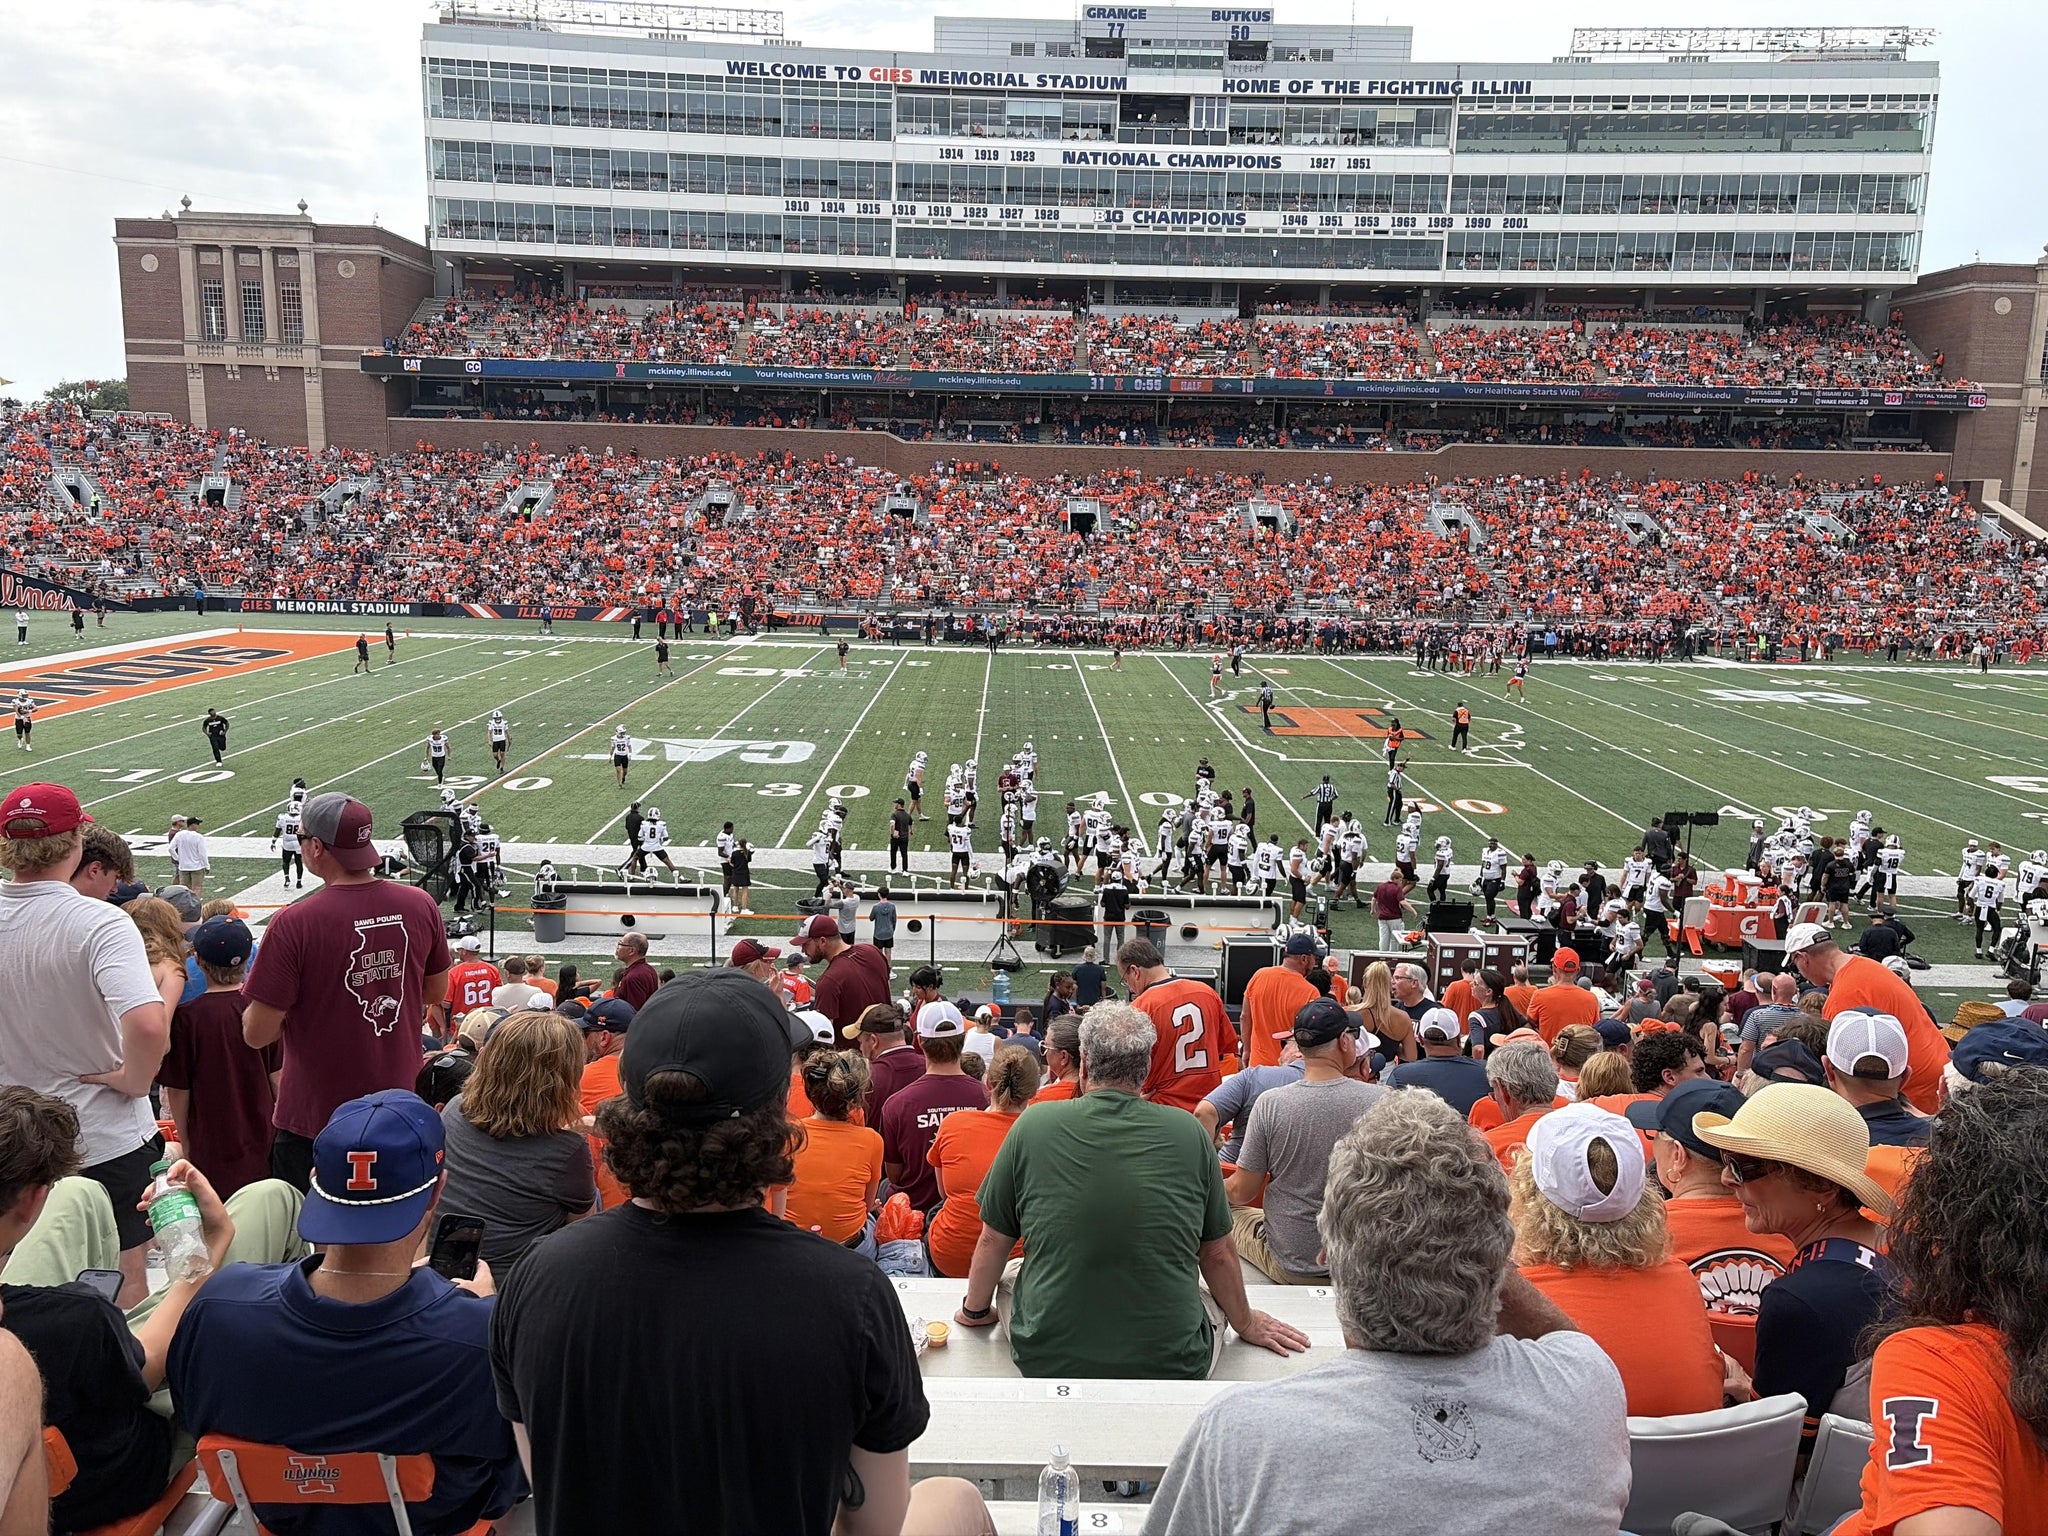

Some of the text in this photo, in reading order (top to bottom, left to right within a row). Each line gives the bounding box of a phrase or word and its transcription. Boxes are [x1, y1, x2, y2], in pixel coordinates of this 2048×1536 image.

[1086, 8, 1147, 20] GRANGE
[1211, 11, 1270, 22] BUTKUS
[1107, 23, 1125, 38] 77
[1230, 26, 1250, 40] 50
[727, 61, 1127, 90] WELCOME TO GIES MEMORIAL STADIUM
[1222, 79, 1532, 95] HOME OF THE FIGHTING ILLINI
[939, 148, 1036, 162] 1914 1919 1923
[1062, 150, 1282, 169] NATIONAL CHAMPIONS
[1310, 158, 1371, 170] 1927 1951
[785, 200, 1060, 220] 1910 1914 1915 1918 1919 1923 1927 1928
[1132, 210, 1246, 226] CHAMPIONS
[1282, 215, 1529, 229] 1946 1951 1953 1963 1983 1990 2001
[403, 359, 422, 372] CAT
[467, 362, 480, 371] CC
[648, 368, 732, 377] mckinley.illinois.edu
[755, 370, 773, 379] Your
[776, 370, 822, 381] Healthcare
[825, 373, 848, 381] Starts
[851, 374, 872, 382] With
[938, 376, 1021, 386] mckinley.illinois.edu
[1135, 379, 1161, 391] 0:55
[1180, 381, 1202, 391] HALF
[1357, 385, 1440, 393] mckinley.illinois.edu
[1464, 387, 1483, 395] Your
[1485, 387, 1530, 396] Healthcare
[1558, 389, 1580, 397] With
[1647, 391, 1731, 400] mckinley.illinois.edu
[1886, 393, 1901, 404] 301
[1969, 397, 1985, 407] 146
[241, 600, 410, 615] GIES MEMORIAL STADIUM
[517, 607, 577, 619] ILLOIS
[756, 783, 871, 798] 30
[1074, 790, 1184, 806] 40
[1087, 818, 1098, 828] 80
[650, 827, 656, 838] 8
[1217, 829, 1227, 838] 19
[951, 834, 963, 845] 27
[1260, 852, 1270, 863] 13
[1887, 859, 1899, 868] 18
[1634, 869, 1641, 878] 7
[2022, 870, 2034, 884] 79
[1985, 886, 1994, 898] 6
[354, 914, 402, 927] DAWG POUND
[1740, 915, 1759, 935] G
[361, 949, 395, 969] OUR
[352, 963, 401, 987] STATE
[464, 980, 491, 1006] 62
[1171, 1001, 1208, 1074] 2
[927, 1106, 956, 1114] SOUTHERN
[346, 1151, 378, 1191] I
[1056, 1385, 1070, 1397] 8
[1882, 1396, 1939, 1471] I
[283, 1467, 340, 1481] ILLINOIS
[1091, 1513, 1108, 1528] 8
